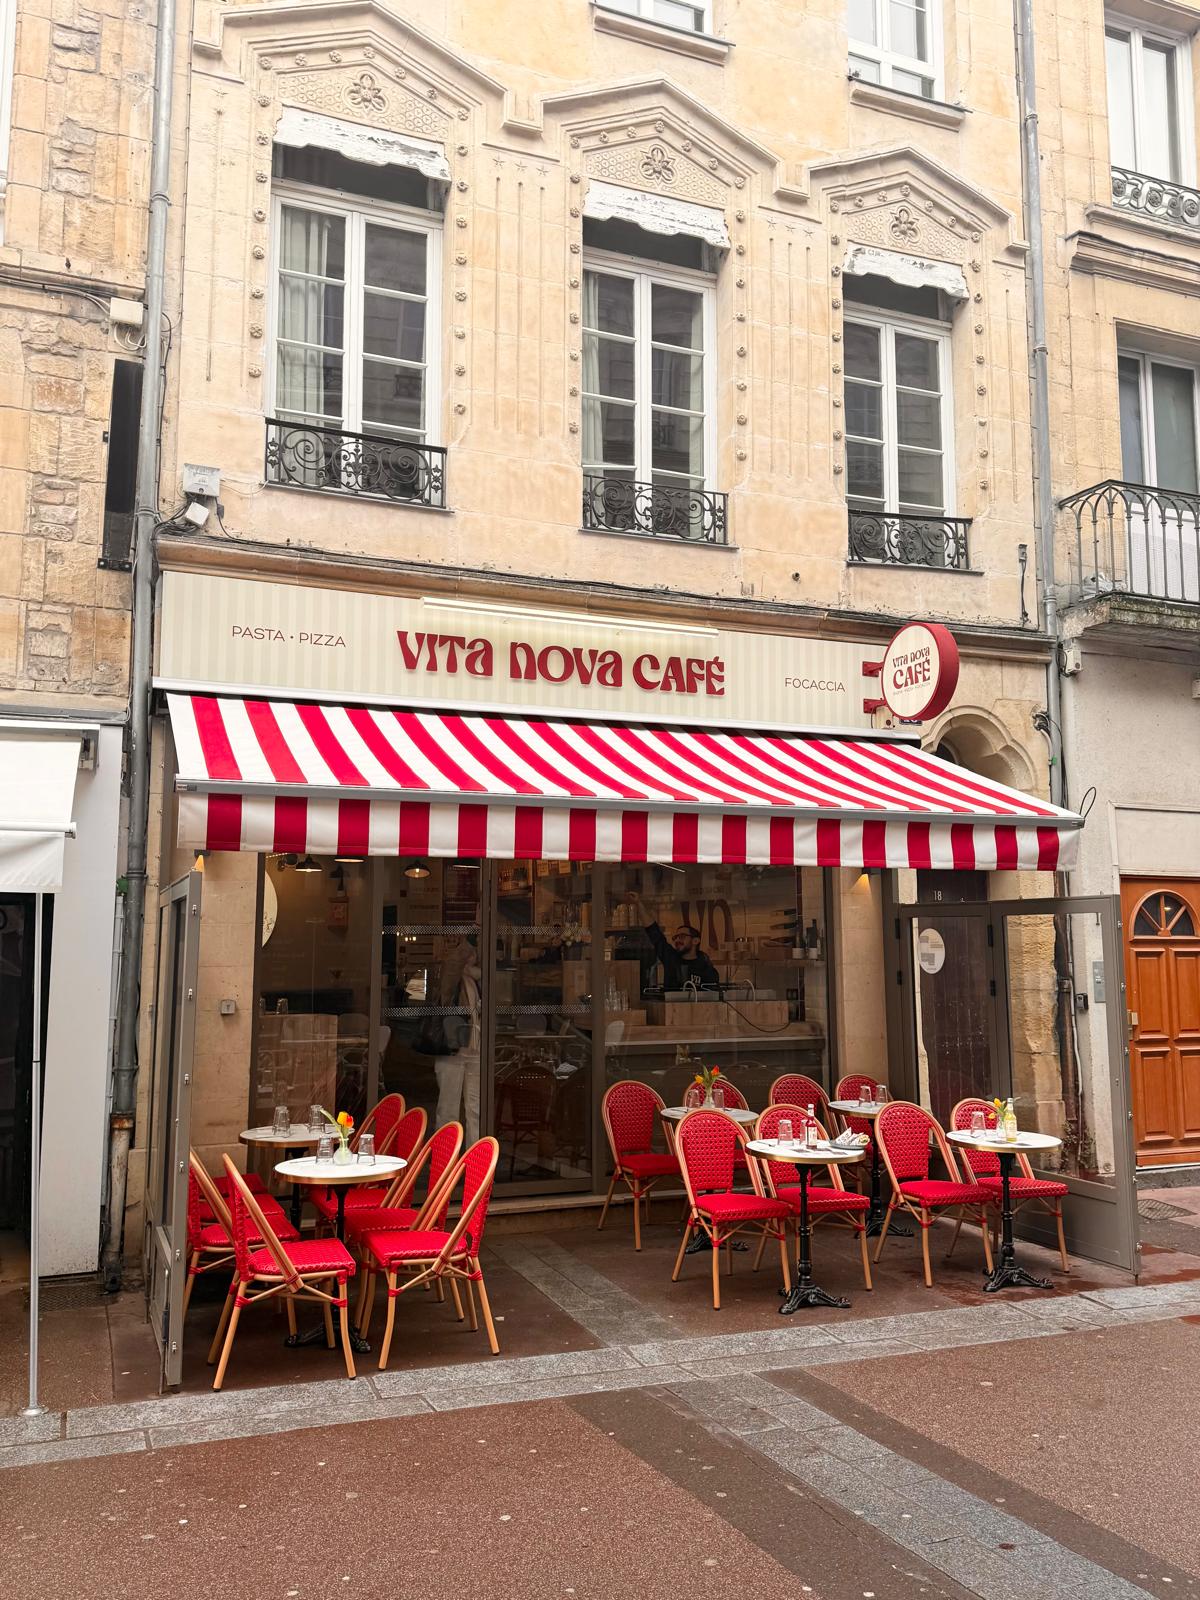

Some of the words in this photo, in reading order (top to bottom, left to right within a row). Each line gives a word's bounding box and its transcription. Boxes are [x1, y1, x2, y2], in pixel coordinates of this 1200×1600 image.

[232, 625, 285, 641] PASTA
[299, 632, 346, 648] PIZZA
[632, 656, 725, 696] CAFÉ
[893, 657, 930, 689] CAFÉ
[784, 677, 846, 693] FOCACCIA
[934, 890, 942, 901] 18
